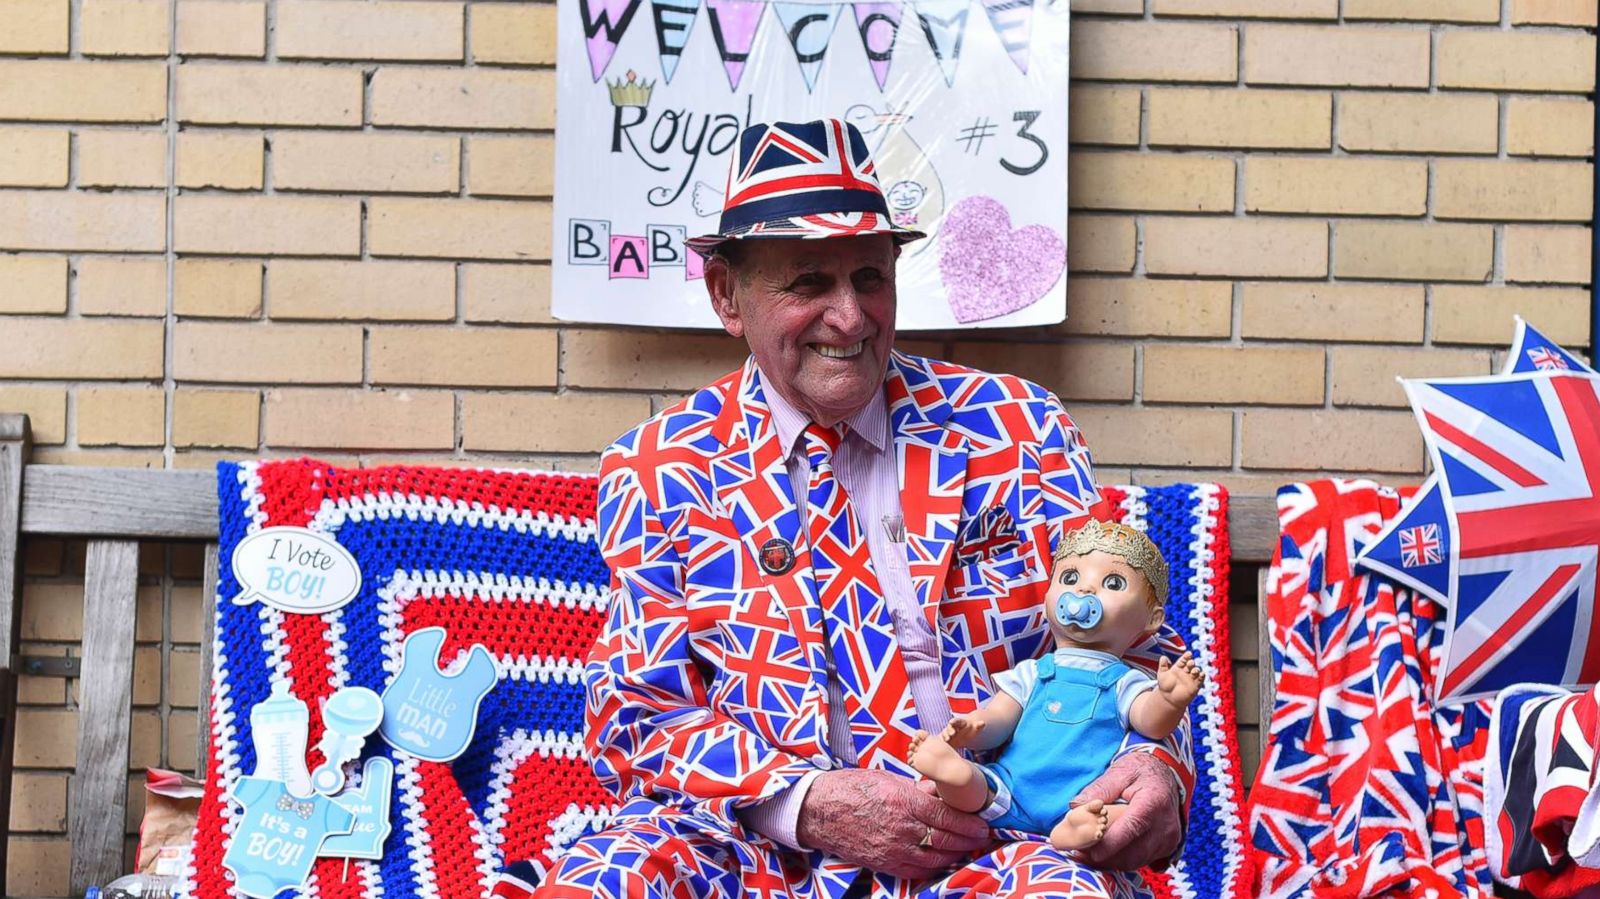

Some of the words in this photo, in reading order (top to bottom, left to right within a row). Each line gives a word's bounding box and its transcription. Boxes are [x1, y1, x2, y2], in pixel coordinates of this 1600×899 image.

[578, 0, 1034, 62] WELCOME
[955, 110, 1049, 176] #3
[574, 223, 678, 272] BAB
[267, 538, 282, 560] I
[288, 540, 336, 571] Vote
[408, 677, 457, 718] Little
[294, 826, 308, 840] a
